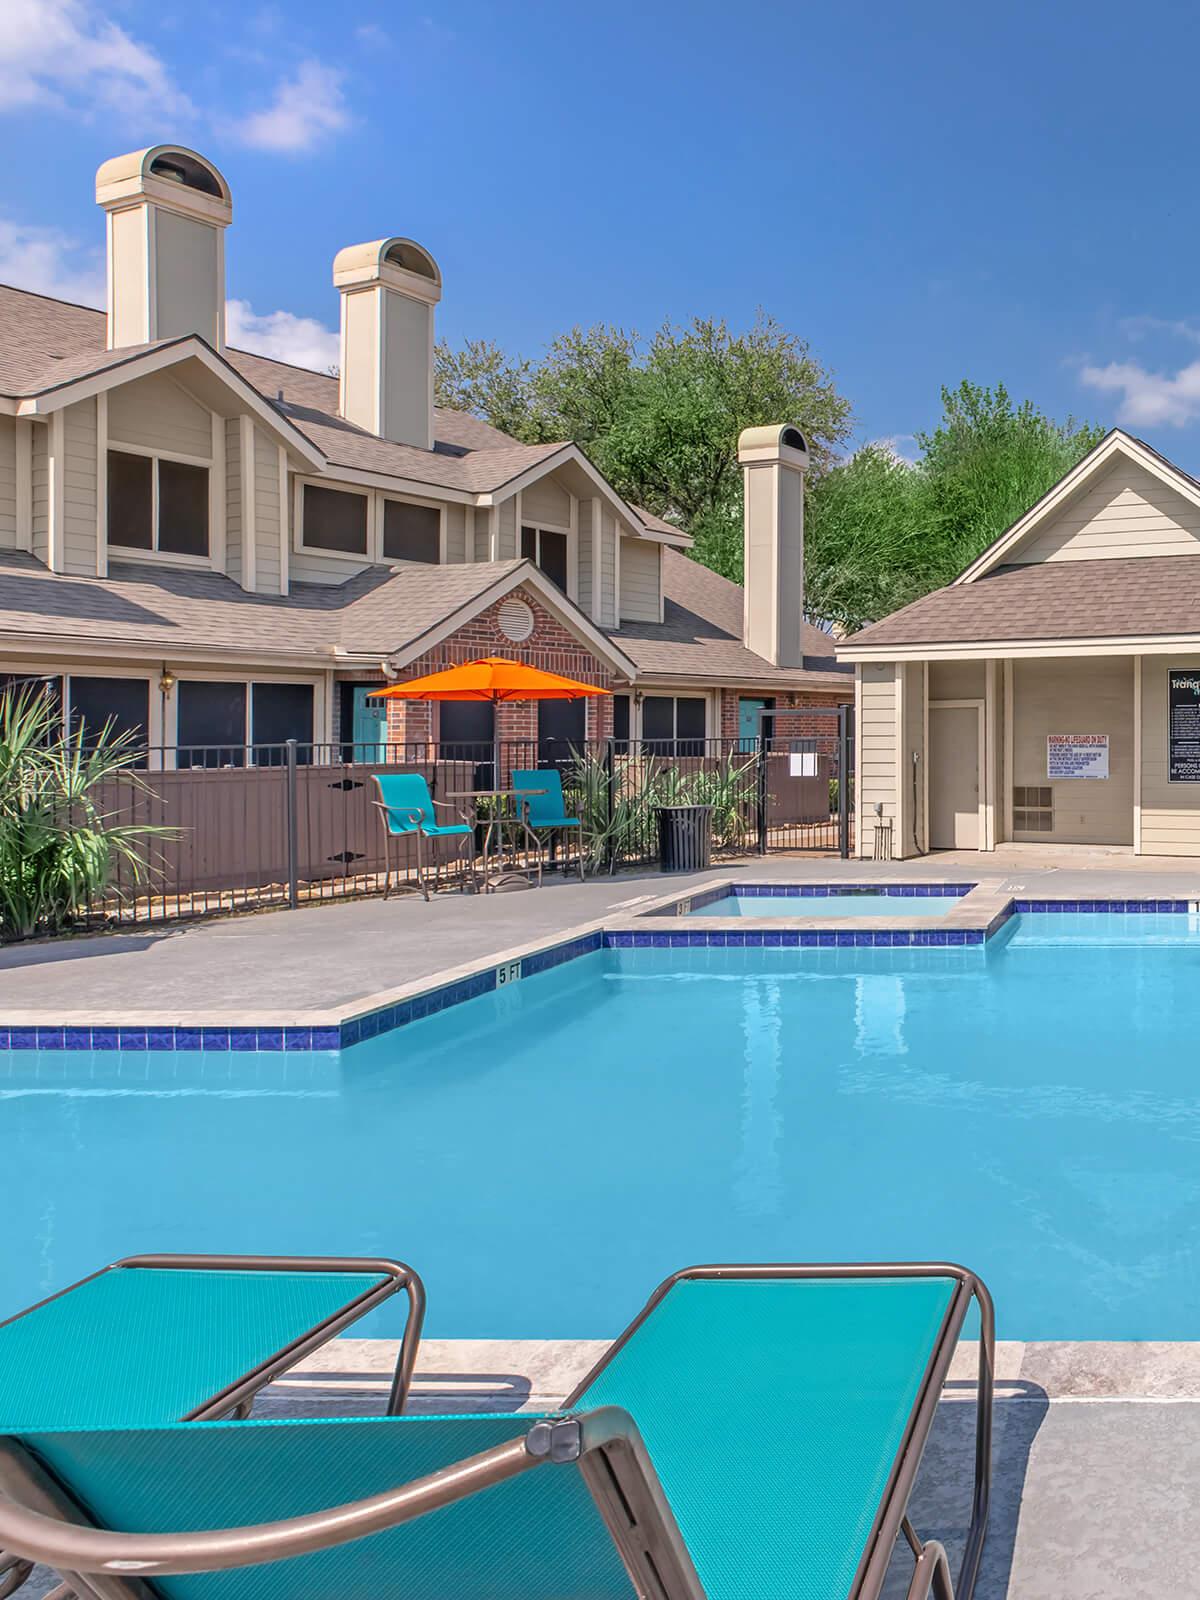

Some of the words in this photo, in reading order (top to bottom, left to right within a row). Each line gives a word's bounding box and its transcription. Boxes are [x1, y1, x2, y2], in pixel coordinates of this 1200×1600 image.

[1194, 901, 1200, 913] 1
[499, 967, 506, 984] 5
[510, 962, 521, 981] FT
